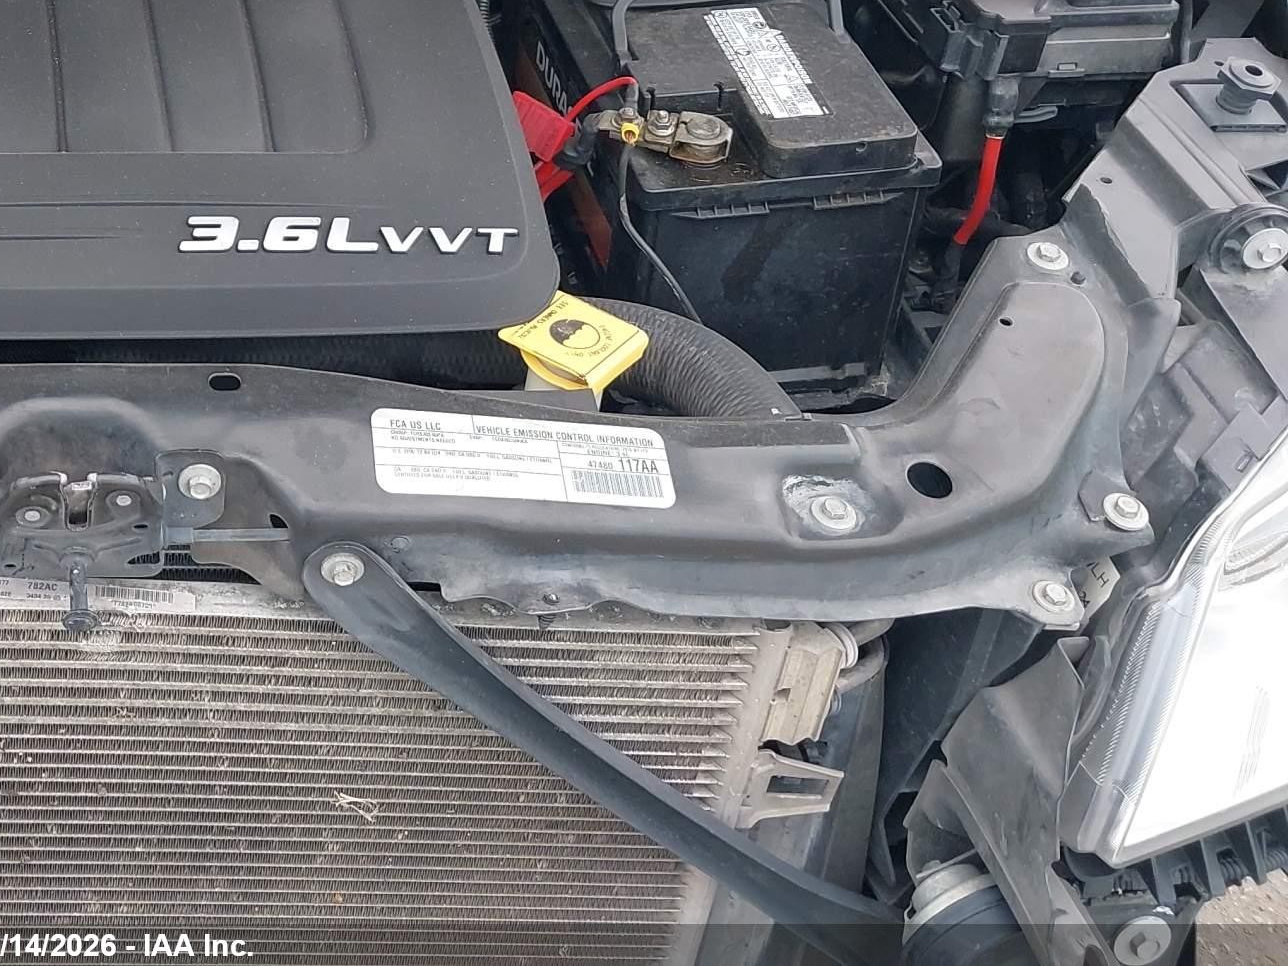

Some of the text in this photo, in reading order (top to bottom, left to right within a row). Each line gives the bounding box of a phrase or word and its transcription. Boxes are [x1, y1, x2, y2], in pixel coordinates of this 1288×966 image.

[389, 419, 441, 431] FCA US LLC
[475, 425, 512, 437] VEHICLE
[513, 427, 554, 440] EMISSION
[556, 431, 595, 443] CONTROL
[596, 434, 654, 448] INFORMATION
[619, 457, 659, 473] 117AA
[1090, 562, 1110, 588] LH
[27, 581, 58, 592] 782AC
